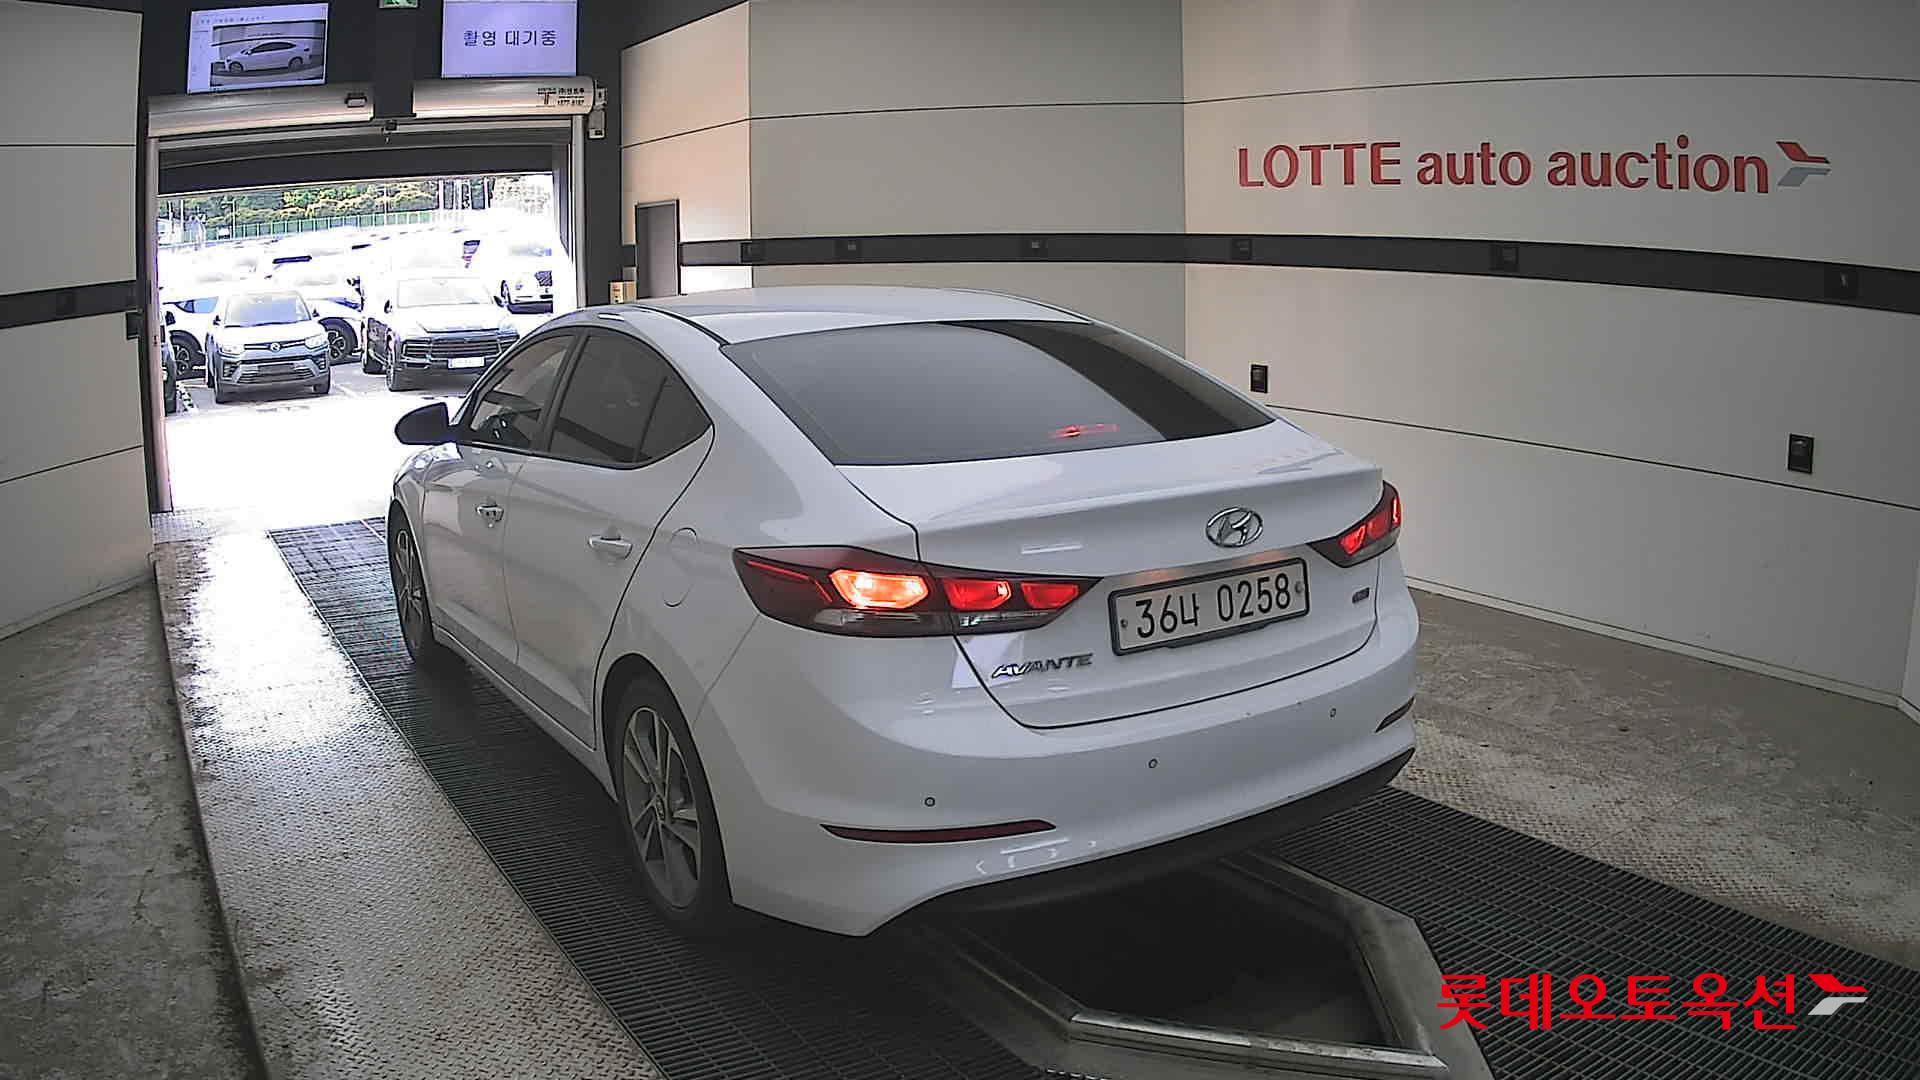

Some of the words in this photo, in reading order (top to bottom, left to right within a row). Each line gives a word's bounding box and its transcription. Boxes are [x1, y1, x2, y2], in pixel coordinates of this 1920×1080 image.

[463, 30, 496, 46] 촬영
[505, 30, 557, 46] 대기중
[1238, 143, 1400, 188] LOTTE
[1416, 142, 1532, 186] auto
[1547, 134, 1769, 193] auction
[1135, 593, 1200, 638] 36나
[1216, 572, 1291, 622] 0258
[991, 652, 1094, 679] AVANTE
